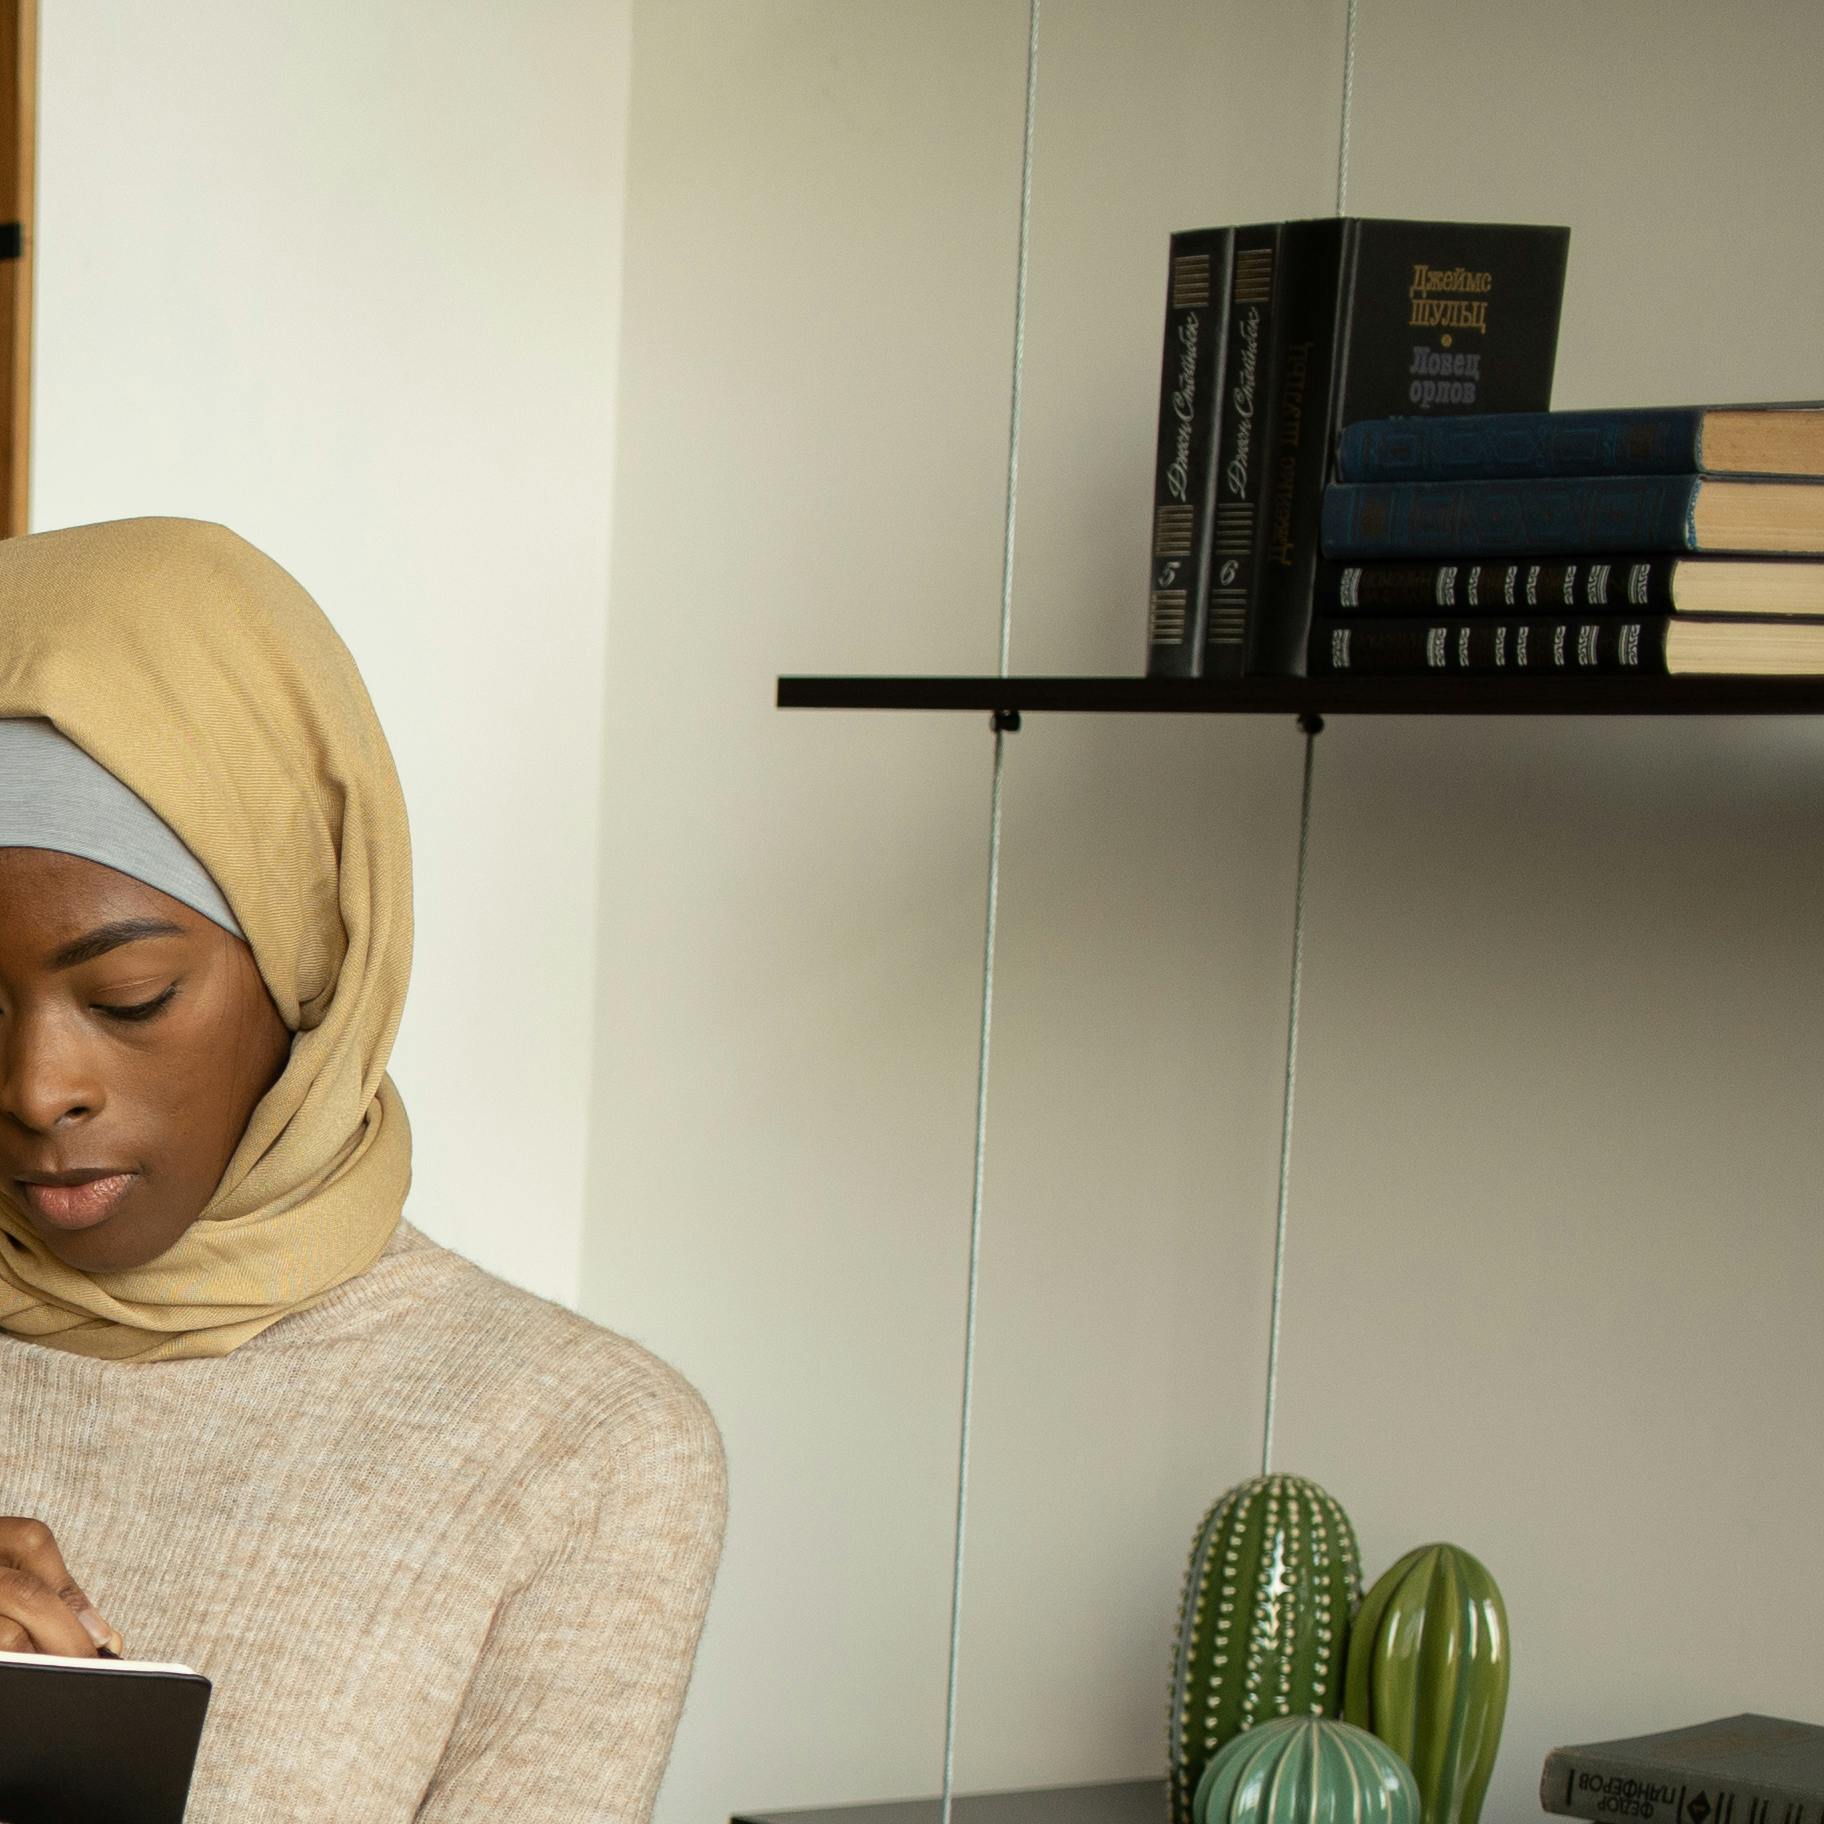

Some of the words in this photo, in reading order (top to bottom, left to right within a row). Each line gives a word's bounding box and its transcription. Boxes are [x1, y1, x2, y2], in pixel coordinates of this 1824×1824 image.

[1409, 264, 1493, 298] Джеймс
[1408, 299, 1489, 335] ШУЛЬЦ
[1409, 346, 1481, 381] Ловец
[1409, 380, 1477, 409] орлов
[1157, 561, 1181, 587] 5
[1219, 560, 1239, 585] 6
[1578, 1773, 1677, 1804] ПАНФЕРОВ
[1596, 1799, 1654, 1820] ФЕДОР
